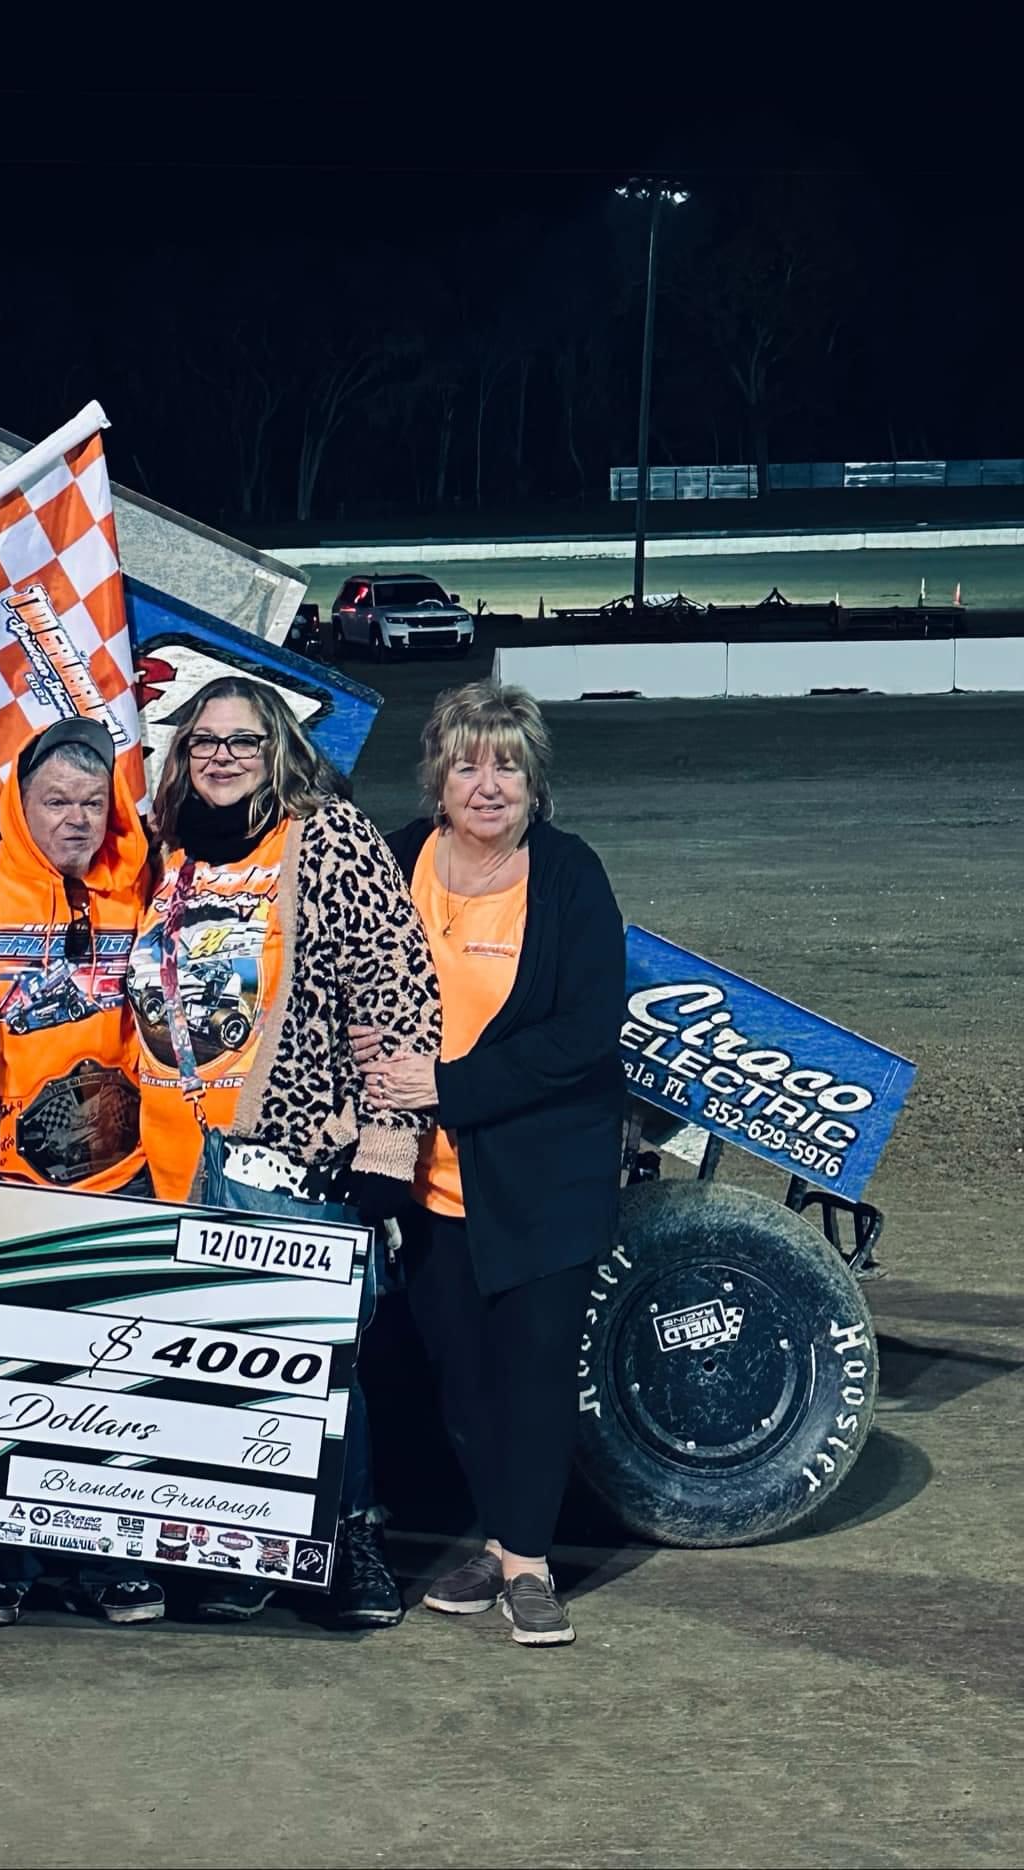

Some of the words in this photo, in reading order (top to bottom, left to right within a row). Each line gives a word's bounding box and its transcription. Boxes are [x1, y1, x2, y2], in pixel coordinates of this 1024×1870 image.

[619, 1020, 858, 1150] ELECTRIC
[621, 1059, 655, 1089] ala
[703, 1097, 843, 1178] 352-629-5976
[199, 1229, 332, 1272] 12/07/2024
[662, 1306, 715, 1328] RACING
[663, 1315, 723, 1344] WELD
[152, 1336, 323, 1385] 4000
[257, 1416, 281, 1438] 0
[801, 1319, 871, 1493] Hoosier
[241, 1441, 292, 1467] 100
[39, 1468, 145, 1500] Brandon
[151, 1483, 272, 1521] Grubaugh
